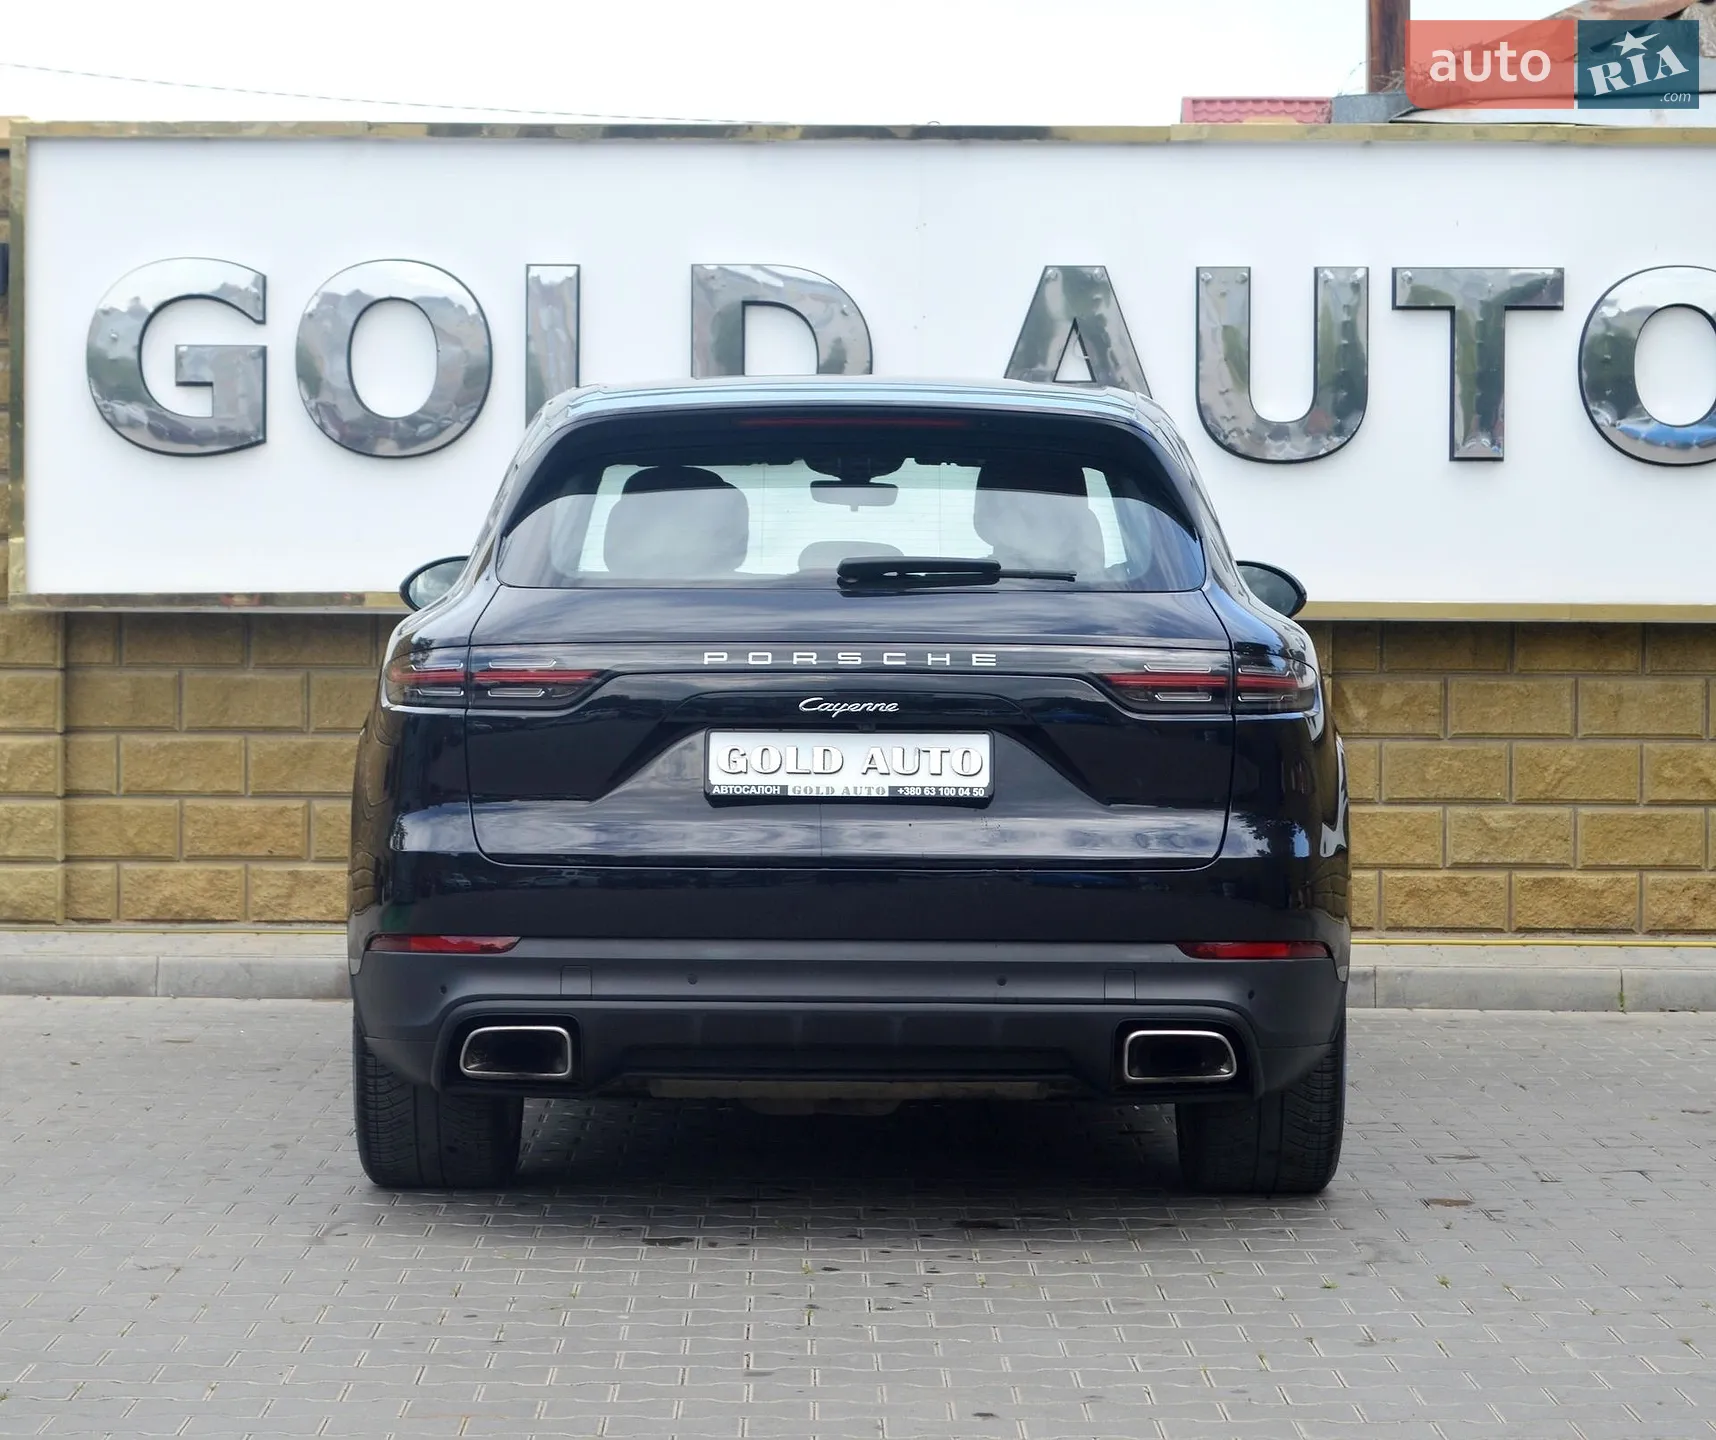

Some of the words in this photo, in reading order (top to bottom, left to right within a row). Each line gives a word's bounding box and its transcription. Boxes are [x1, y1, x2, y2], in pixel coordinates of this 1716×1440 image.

[1003, 264, 1716, 466] AUTO
[703, 651, 998, 667] PORSCHE
[798, 696, 901, 718] Cayenne
[717, 745, 844, 776] GOLD
[861, 746, 984, 777] AUTO
[712, 785, 781, 795] АВТОСАЛОН
[791, 786, 836, 797] GOLD
[841, 786, 887, 797] AUTO
[897, 787, 922, 796] +380
[924, 787, 936, 796] 63
[939, 787, 957, 796] 100
[958, 787, 971, 796] 04
[972, 787, 985, 797] 50
